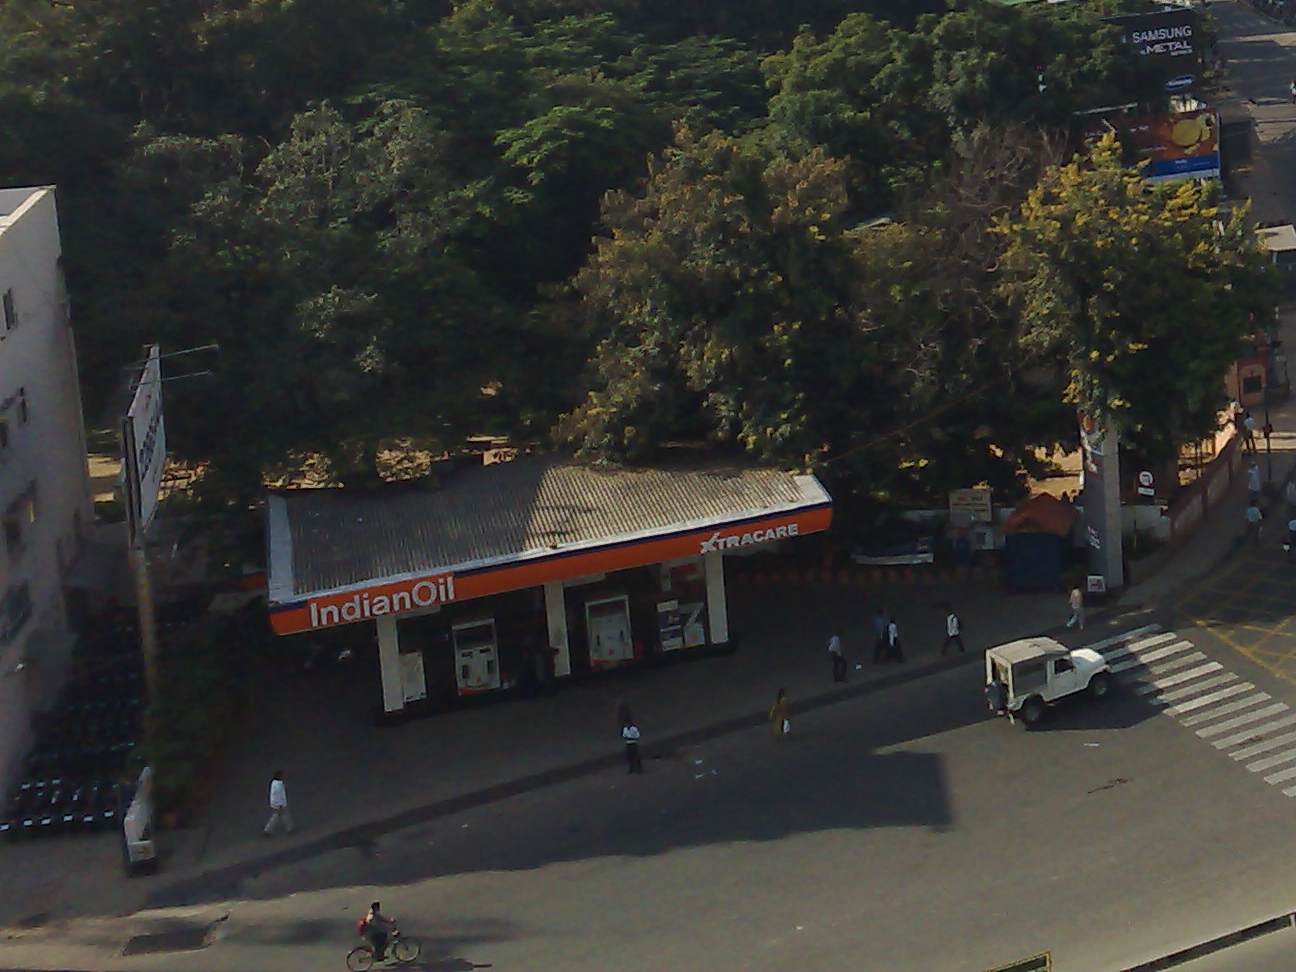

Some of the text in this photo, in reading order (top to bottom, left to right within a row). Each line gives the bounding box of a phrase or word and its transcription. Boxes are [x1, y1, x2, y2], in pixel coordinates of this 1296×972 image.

[1132, 25, 1192, 43] SAMSUNG
[1146, 40, 1192, 54] METAL
[700, 524, 799, 554] XTRACARE
[309, 576, 456, 627] IndianOil
